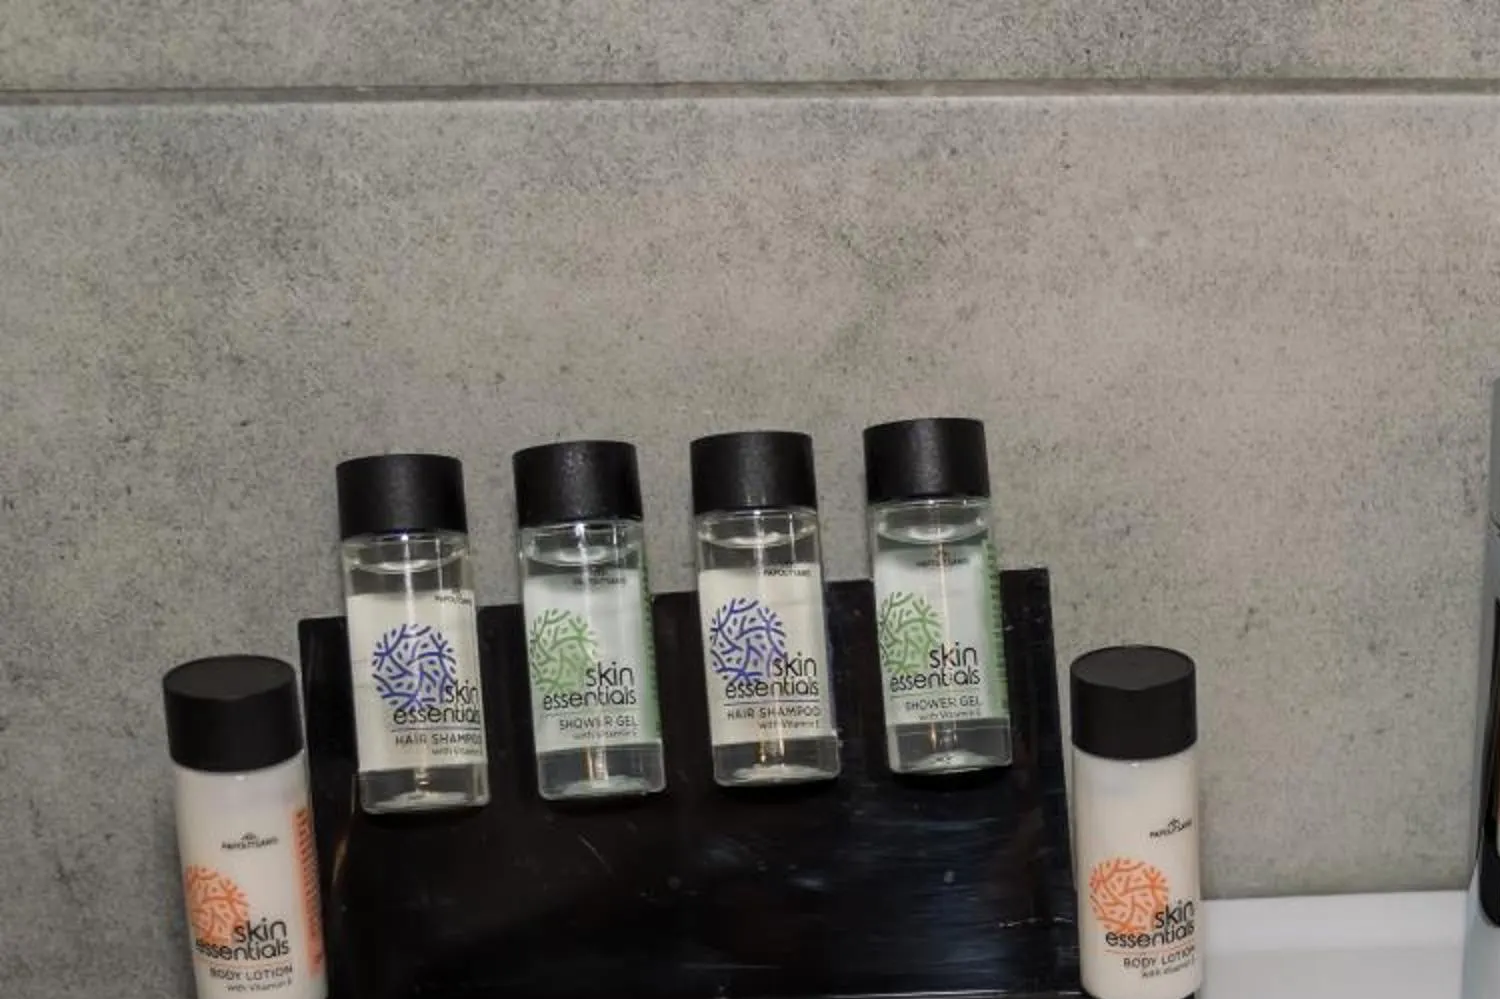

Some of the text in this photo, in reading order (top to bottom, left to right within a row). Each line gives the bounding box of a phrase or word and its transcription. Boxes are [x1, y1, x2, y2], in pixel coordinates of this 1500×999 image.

[773, 652, 817, 677] skin
[929, 641, 977, 669] skin
[585, 661, 634, 687] skin
[445, 680, 478, 703] skin
[543, 685, 637, 711] essentials
[725, 677, 819, 698] essentials
[959, 695, 982, 707] GEL
[616, 715, 638, 728] GEL
[727, 707, 754, 719] HAIR
[395, 734, 427, 746] HAIR
[1154, 900, 1194, 929] skin
[233, 917, 287, 943] skin
[210, 964, 293, 981] BODY LOTION
[1123, 956, 1156, 969] BODY
